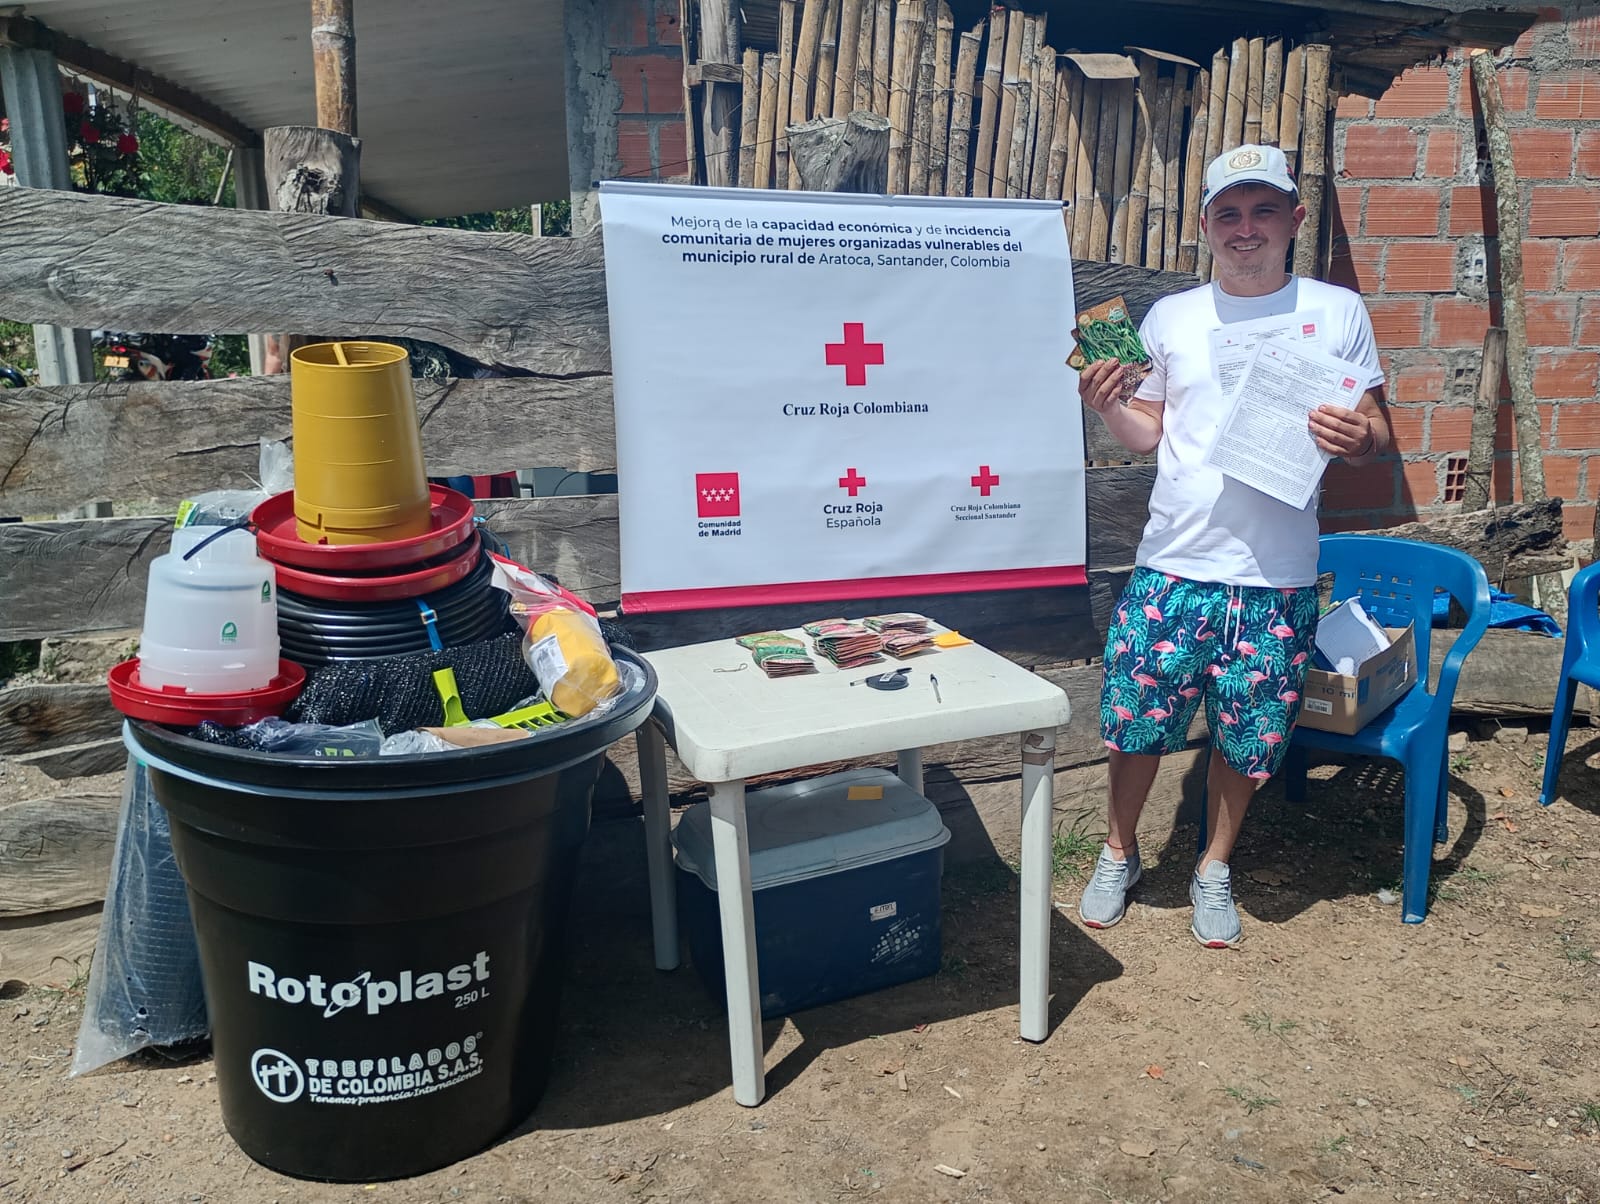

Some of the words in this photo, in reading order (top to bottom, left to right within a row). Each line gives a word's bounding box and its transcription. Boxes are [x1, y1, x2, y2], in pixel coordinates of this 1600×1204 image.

[671, 216, 720, 231] Mejora
[724, 217, 742, 229] de
[746, 218, 758, 229] la
[762, 219, 834, 232] capacidad
[838, 222, 912, 234] económica
[915, 227, 922, 236] y
[926, 225, 942, 235] de
[944, 225, 1011, 237] incidencia
[662, 232, 751, 246] comunitaria
[756, 234, 774, 246] de
[778, 237, 835, 249] mujeres
[839, 237, 922, 251] organizadas
[924, 239, 1000, 251] vulnerables
[1003, 241, 1022, 252] del
[682, 250, 756, 266] municipio
[760, 252, 793, 264] rural
[797, 252, 816, 264] de
[819, 253, 874, 267] Aratoca,
[877, 254, 947, 268] Santander,
[950, 255, 1010, 268] Colombia
[783, 403, 816, 416] Cruz
[819, 402, 849, 417] Roja
[853, 401, 929, 415] Colombiana
[823, 504, 852, 515] Cruz
[856, 501, 883, 514] Roja
[967, 504, 982, 512] Roja
[983, 502, 1021, 510] Colombiana
[698, 520, 741, 529] Comunidad
[826, 516, 881, 529] Española
[955, 513, 984, 521] Seccional
[698, 529, 709, 537] de
[712, 528, 741, 537] Madrid
[1322, 687, 1335, 695] 10
[248, 951, 490, 1017] Rotoplast
[455, 990, 478, 1008] 250
[481, 987, 490, 998] L
[309, 1077, 332, 1094] DE
[337, 1069, 434, 1095] COLOMBIA
[438, 1052, 483, 1080] S.A.S.
[309, 1093, 357, 1105] Tenemos
[357, 1090, 414, 1107] presencia
[413, 1065, 483, 1097] Internacional
